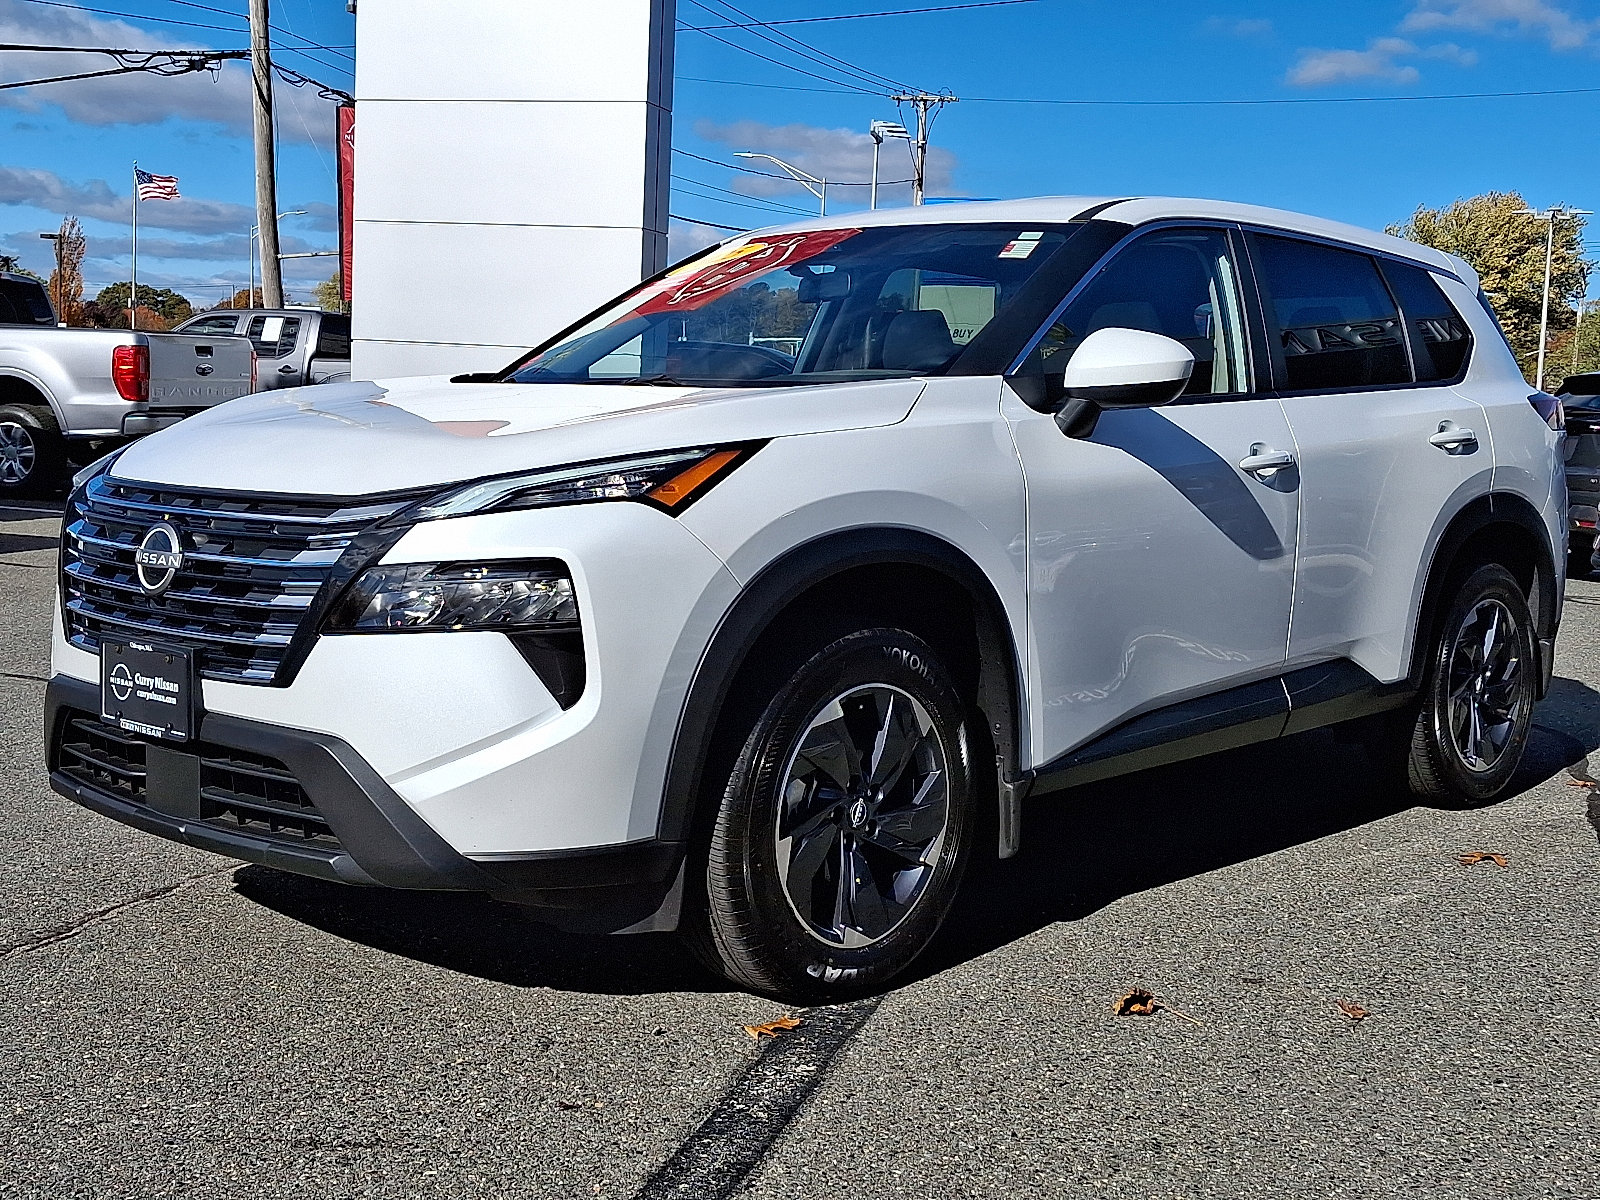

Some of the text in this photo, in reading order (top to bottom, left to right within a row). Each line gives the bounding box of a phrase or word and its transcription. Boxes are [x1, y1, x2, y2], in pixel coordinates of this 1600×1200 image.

[952, 328, 974, 339] BUY
[151, 386, 250, 397] RANGER
[136, 549, 180, 567] NISSAN
[109, 676, 134, 688] NISSAN
[134, 672, 179, 693] Curry Nissan
